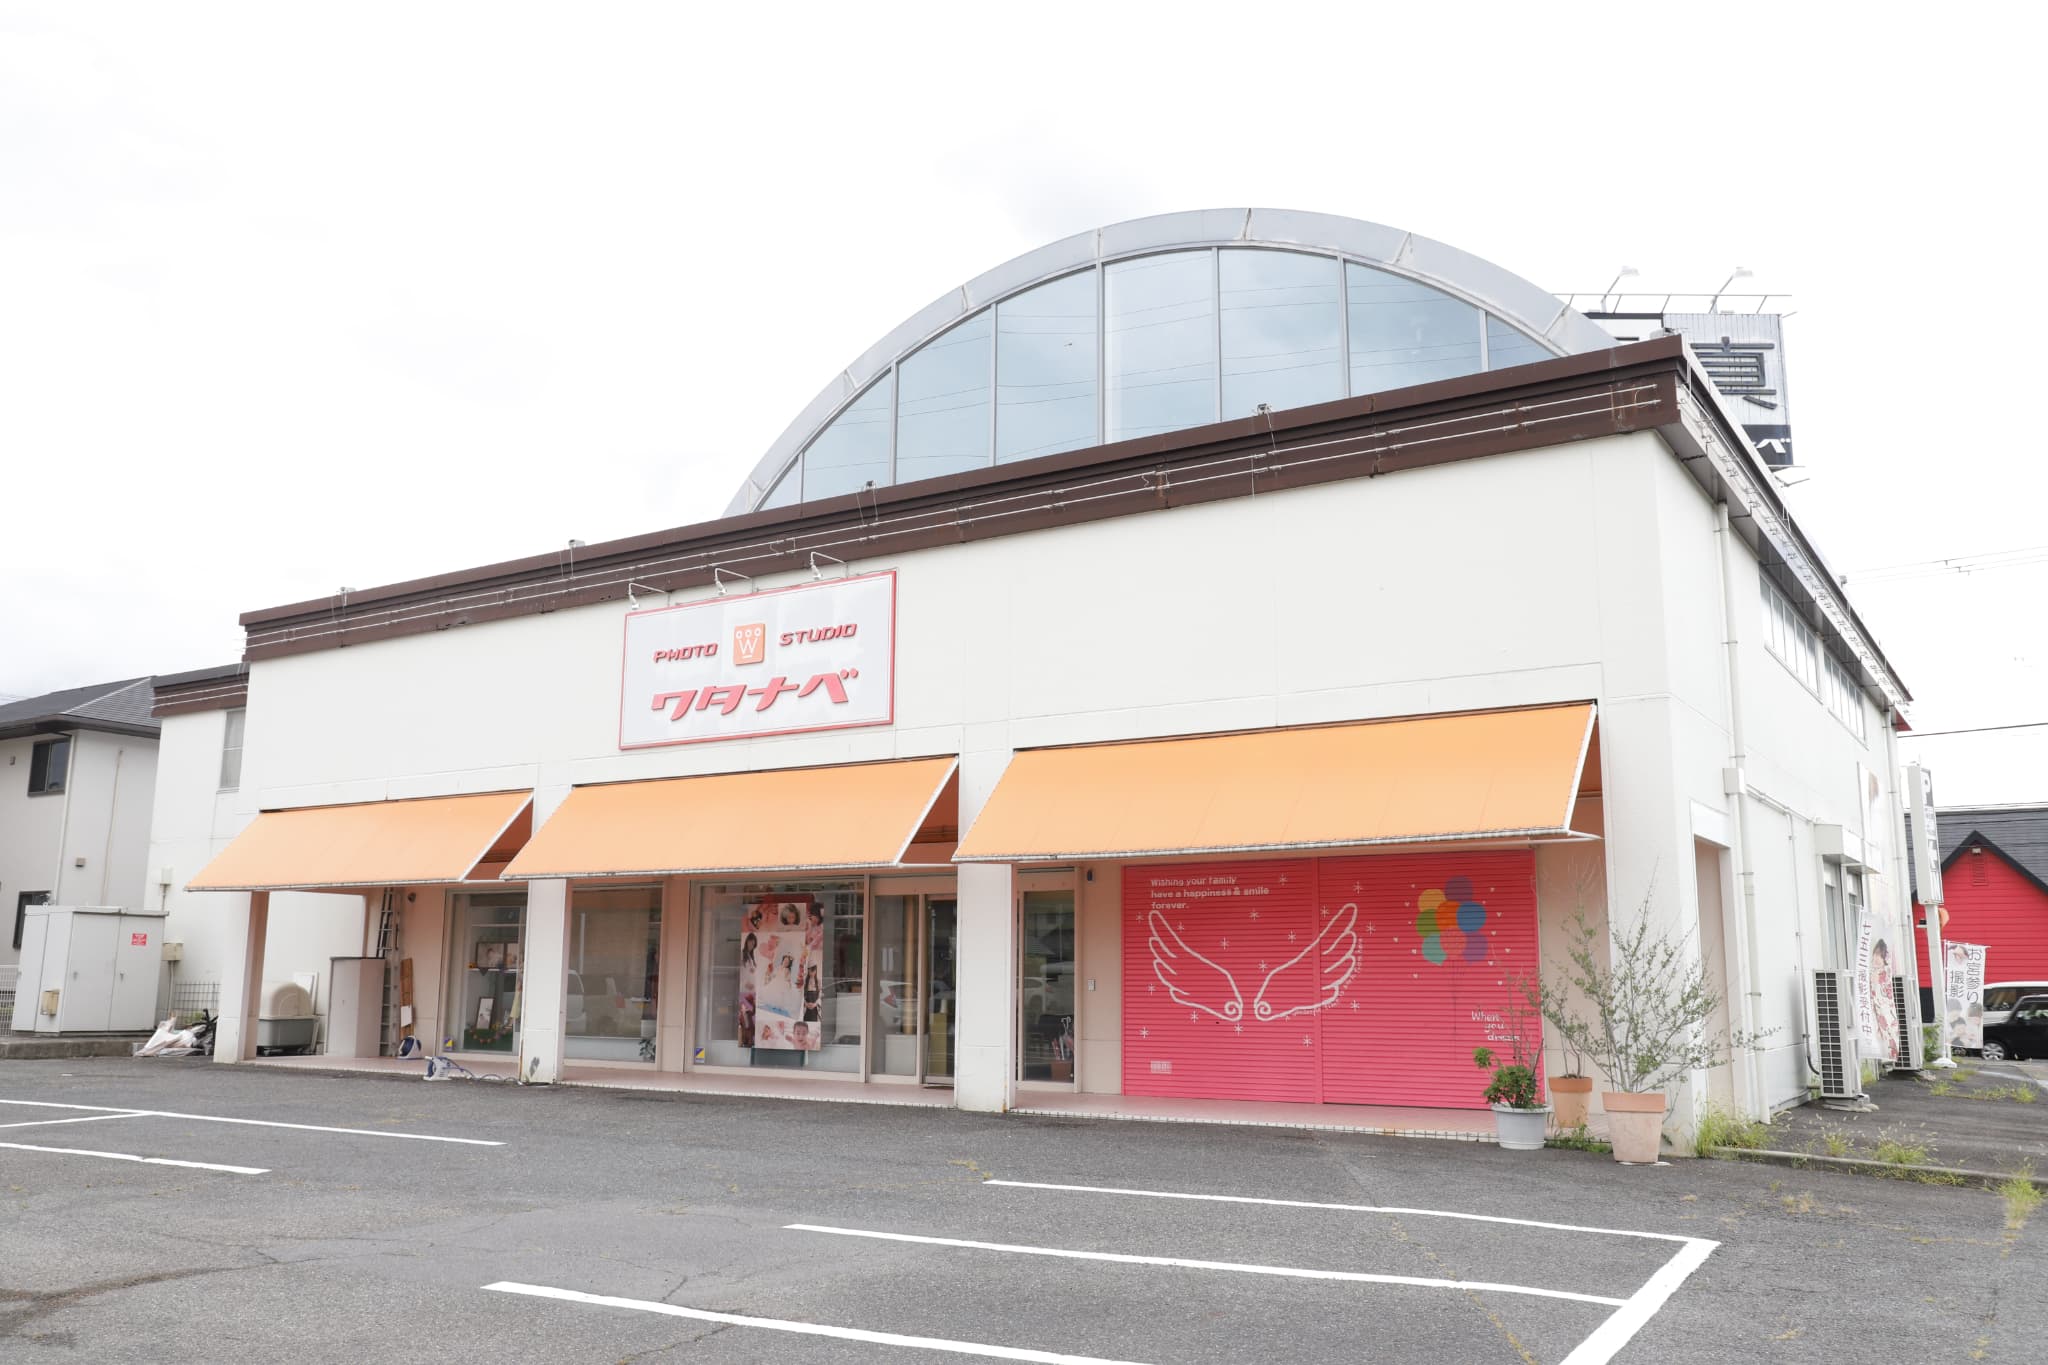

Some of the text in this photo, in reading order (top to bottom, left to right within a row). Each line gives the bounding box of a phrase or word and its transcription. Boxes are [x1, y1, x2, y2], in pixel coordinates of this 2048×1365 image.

[1752, 437, 1791, 454] ベ
[653, 642, 718, 663] PHOTO
[779, 623, 857, 647] STUDIO
[651, 668, 859, 721] ワタナベ
[1151, 875, 1238, 888] Wishing your family
[1151, 888, 1174, 899] have
[1183, 887, 1232, 900] happiness
[1233, 886, 1241, 897] &
[1243, 885, 1270, 897] smile
[1151, 901, 1190, 911] forever.
[1950, 969, 1965, 998] 撮影
[1967, 947, 1983, 1008] お宮参り
